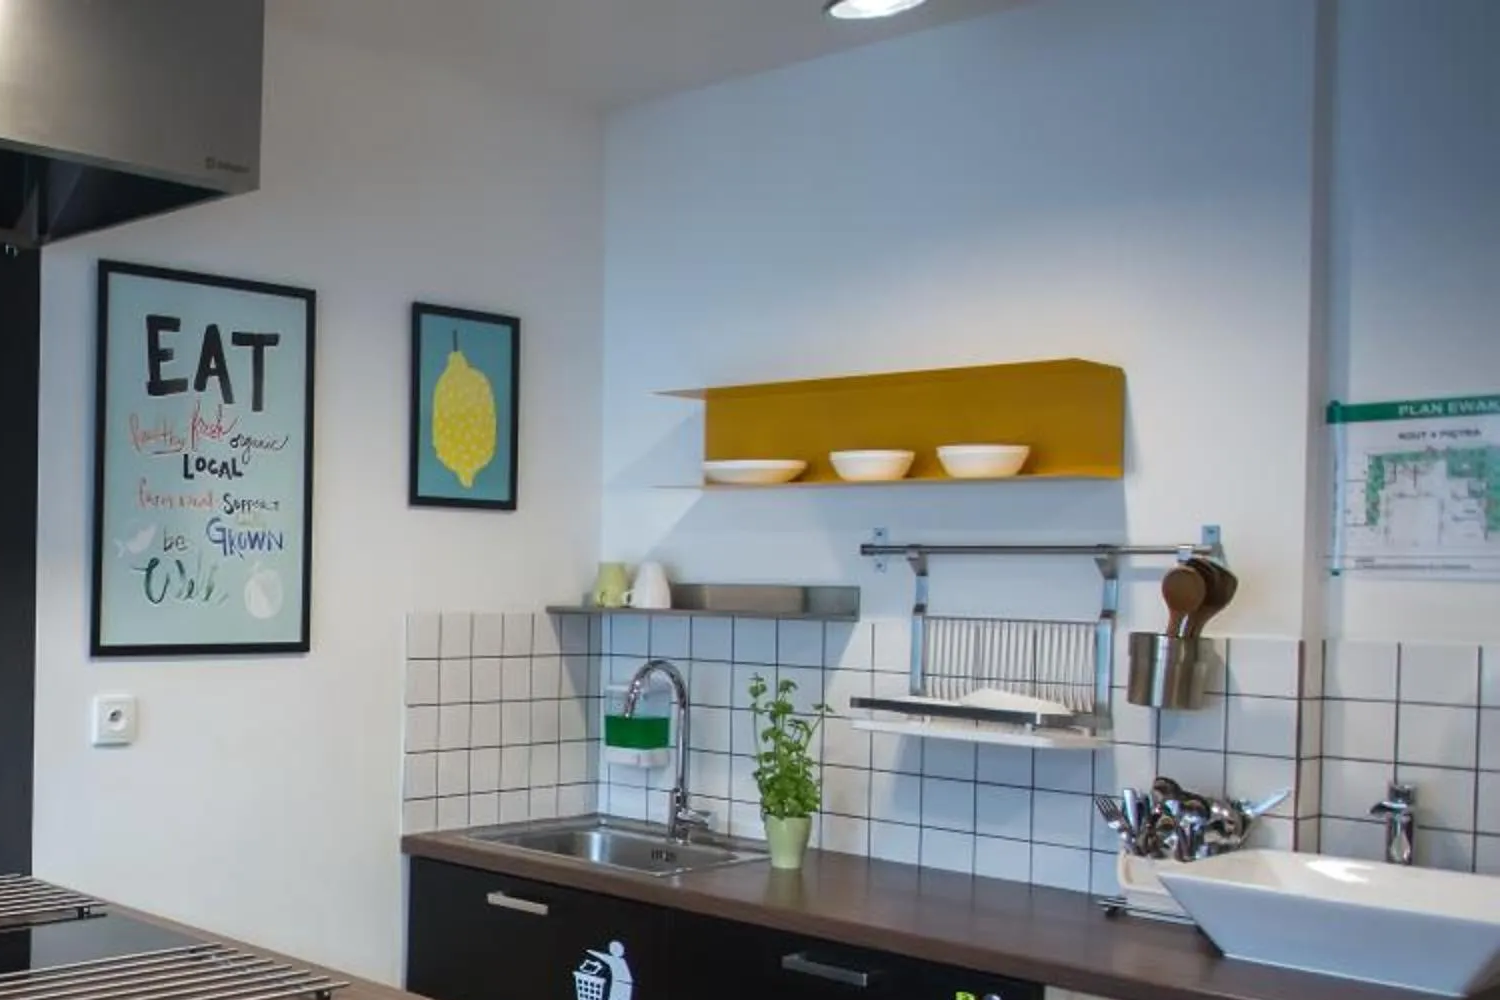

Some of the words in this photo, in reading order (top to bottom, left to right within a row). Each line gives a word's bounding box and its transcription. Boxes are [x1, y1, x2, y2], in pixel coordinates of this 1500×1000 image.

[145, 315, 280, 412] EAT
[1398, 402, 1443, 416] PLAN
[183, 452, 244, 480] LOCAL
[206, 516, 284, 560] GROWN
